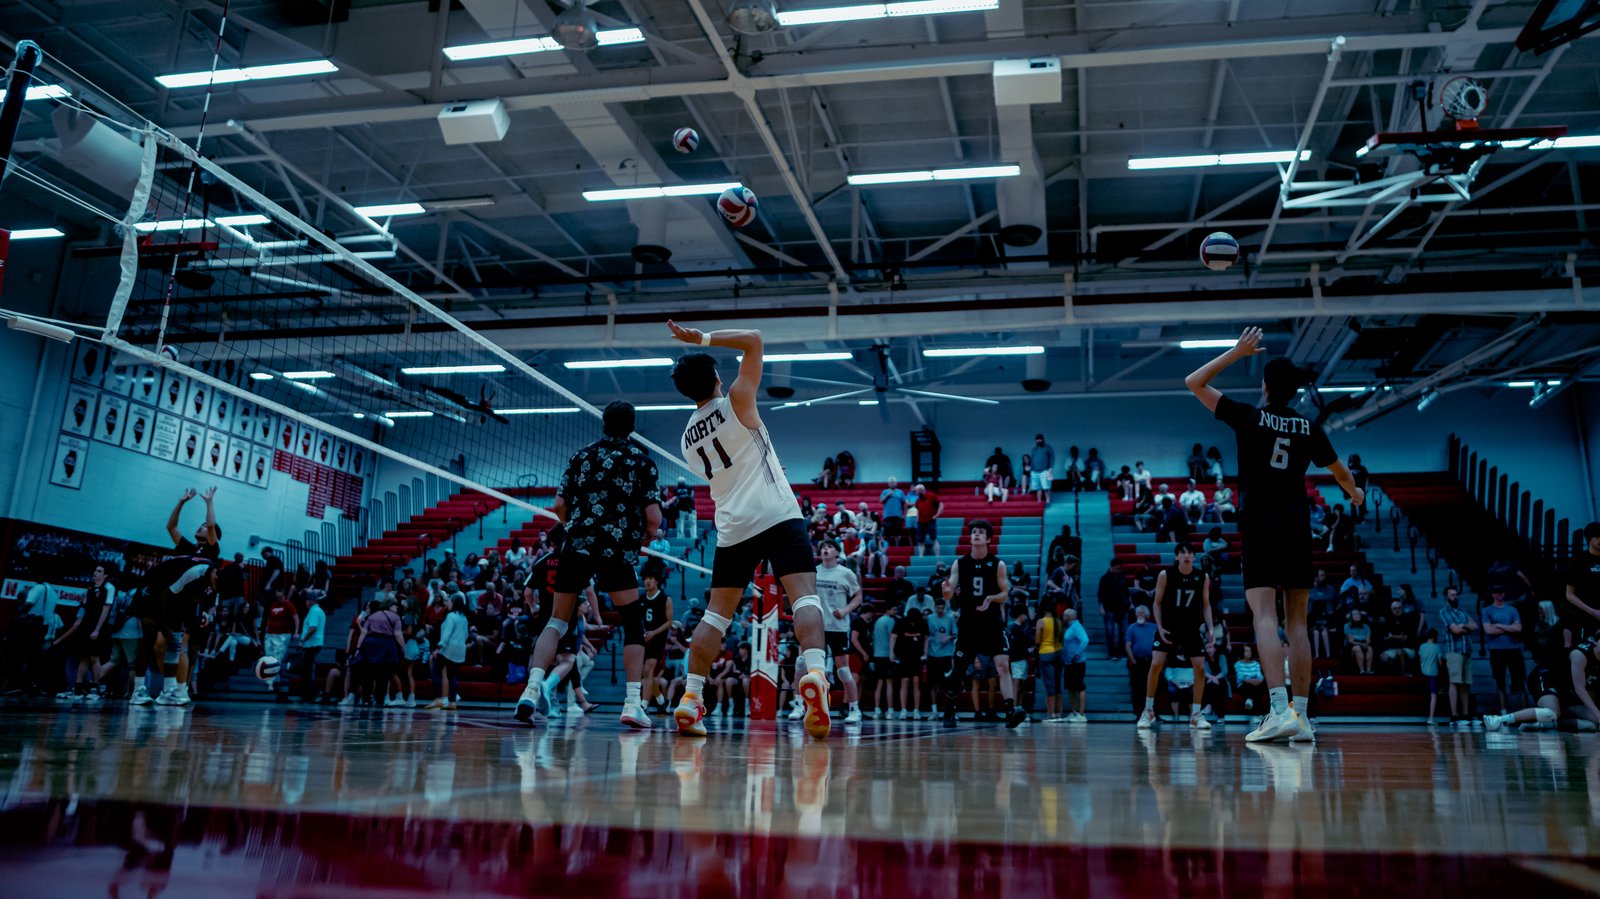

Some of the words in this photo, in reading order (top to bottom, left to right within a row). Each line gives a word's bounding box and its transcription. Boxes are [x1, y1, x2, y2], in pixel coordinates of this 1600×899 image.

[684, 409, 726, 450] NORTH
[1259, 410, 1310, 435] NORTH
[696, 437, 733, 480] 11
[1270, 437, 1290, 470] 6
[973, 576, 984, 597] 9
[1176, 589, 1195, 608] 17
[646, 607, 653, 622] 6
